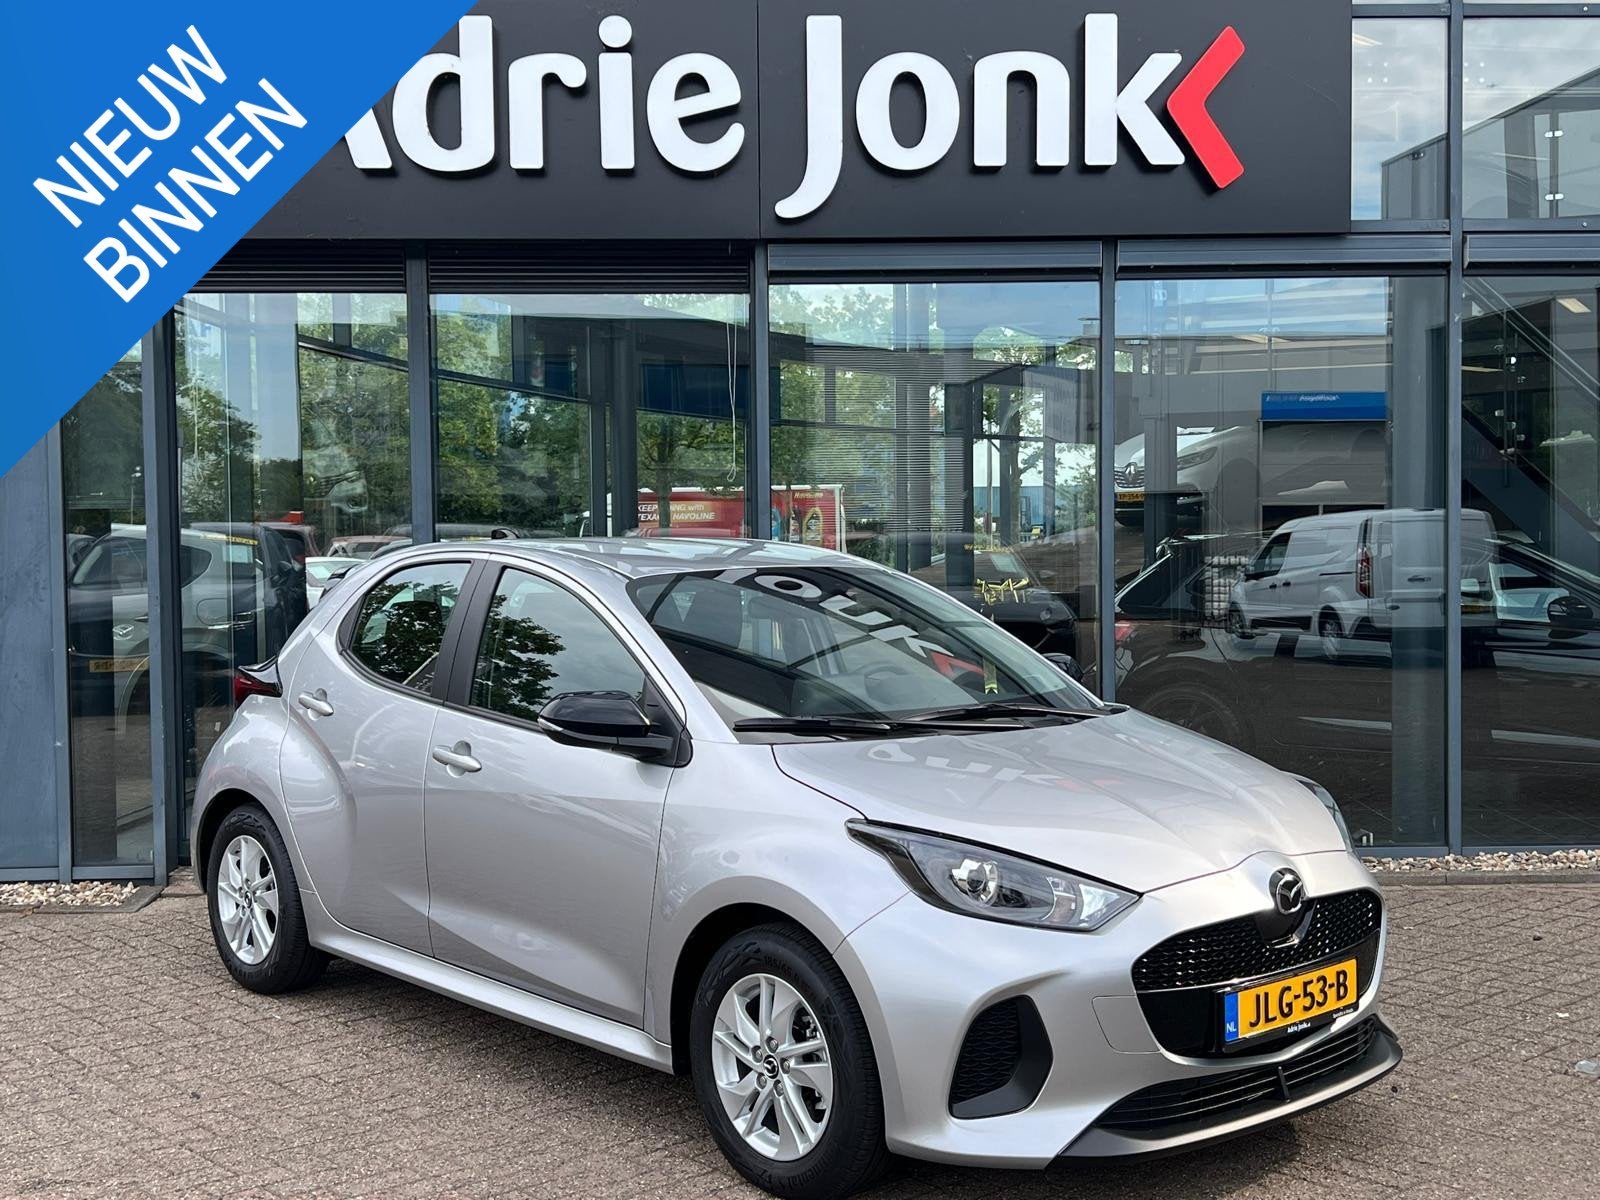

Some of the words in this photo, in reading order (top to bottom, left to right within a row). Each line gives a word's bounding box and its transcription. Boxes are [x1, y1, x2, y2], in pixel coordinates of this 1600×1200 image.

[775, 14, 1184, 219] Jonk
[688, 503, 704, 511] with
[672, 512, 716, 520] HAVOLINE
[1249, 970, 1349, 1028] JLG-53-B
[1226, 1022, 1237, 1034] NL
